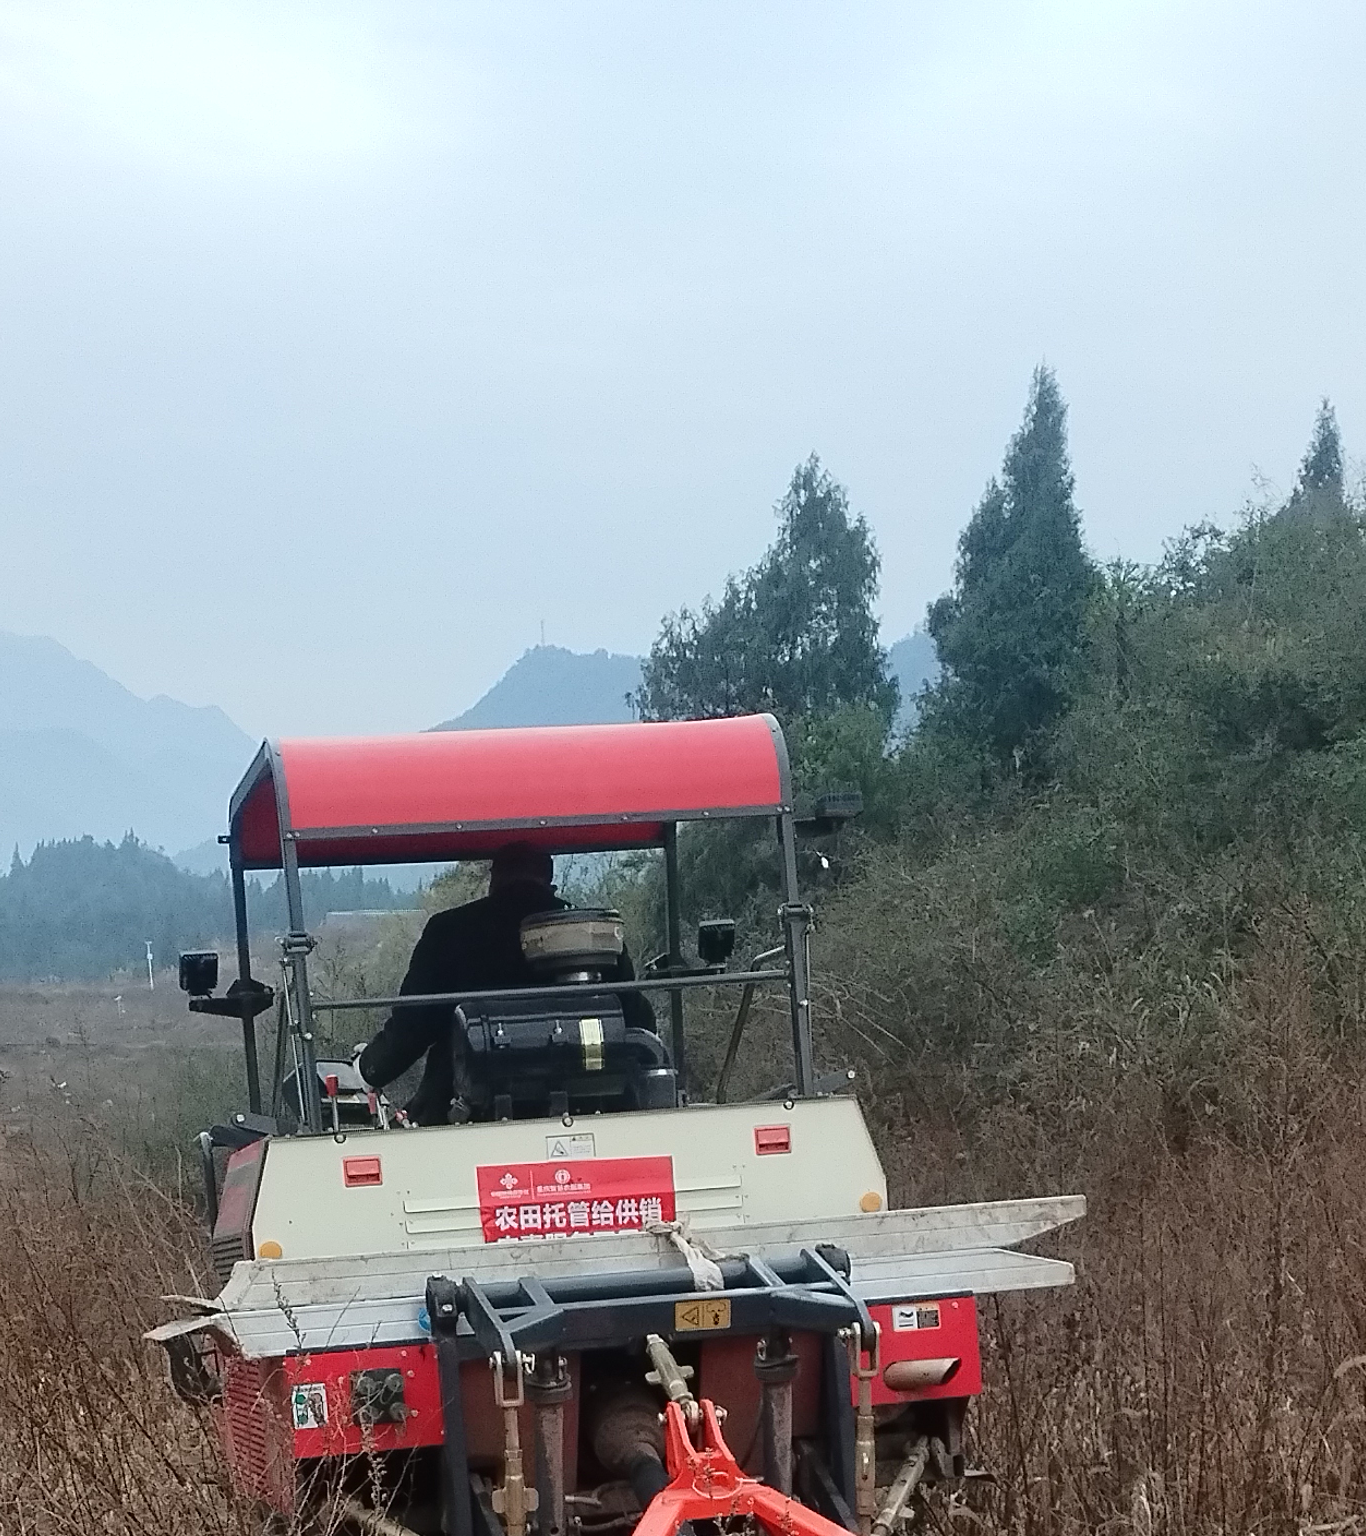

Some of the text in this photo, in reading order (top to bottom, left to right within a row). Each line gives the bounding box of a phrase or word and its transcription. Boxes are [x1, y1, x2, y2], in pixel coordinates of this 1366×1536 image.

[495, 1197, 662, 1231] 农田托管给供销
